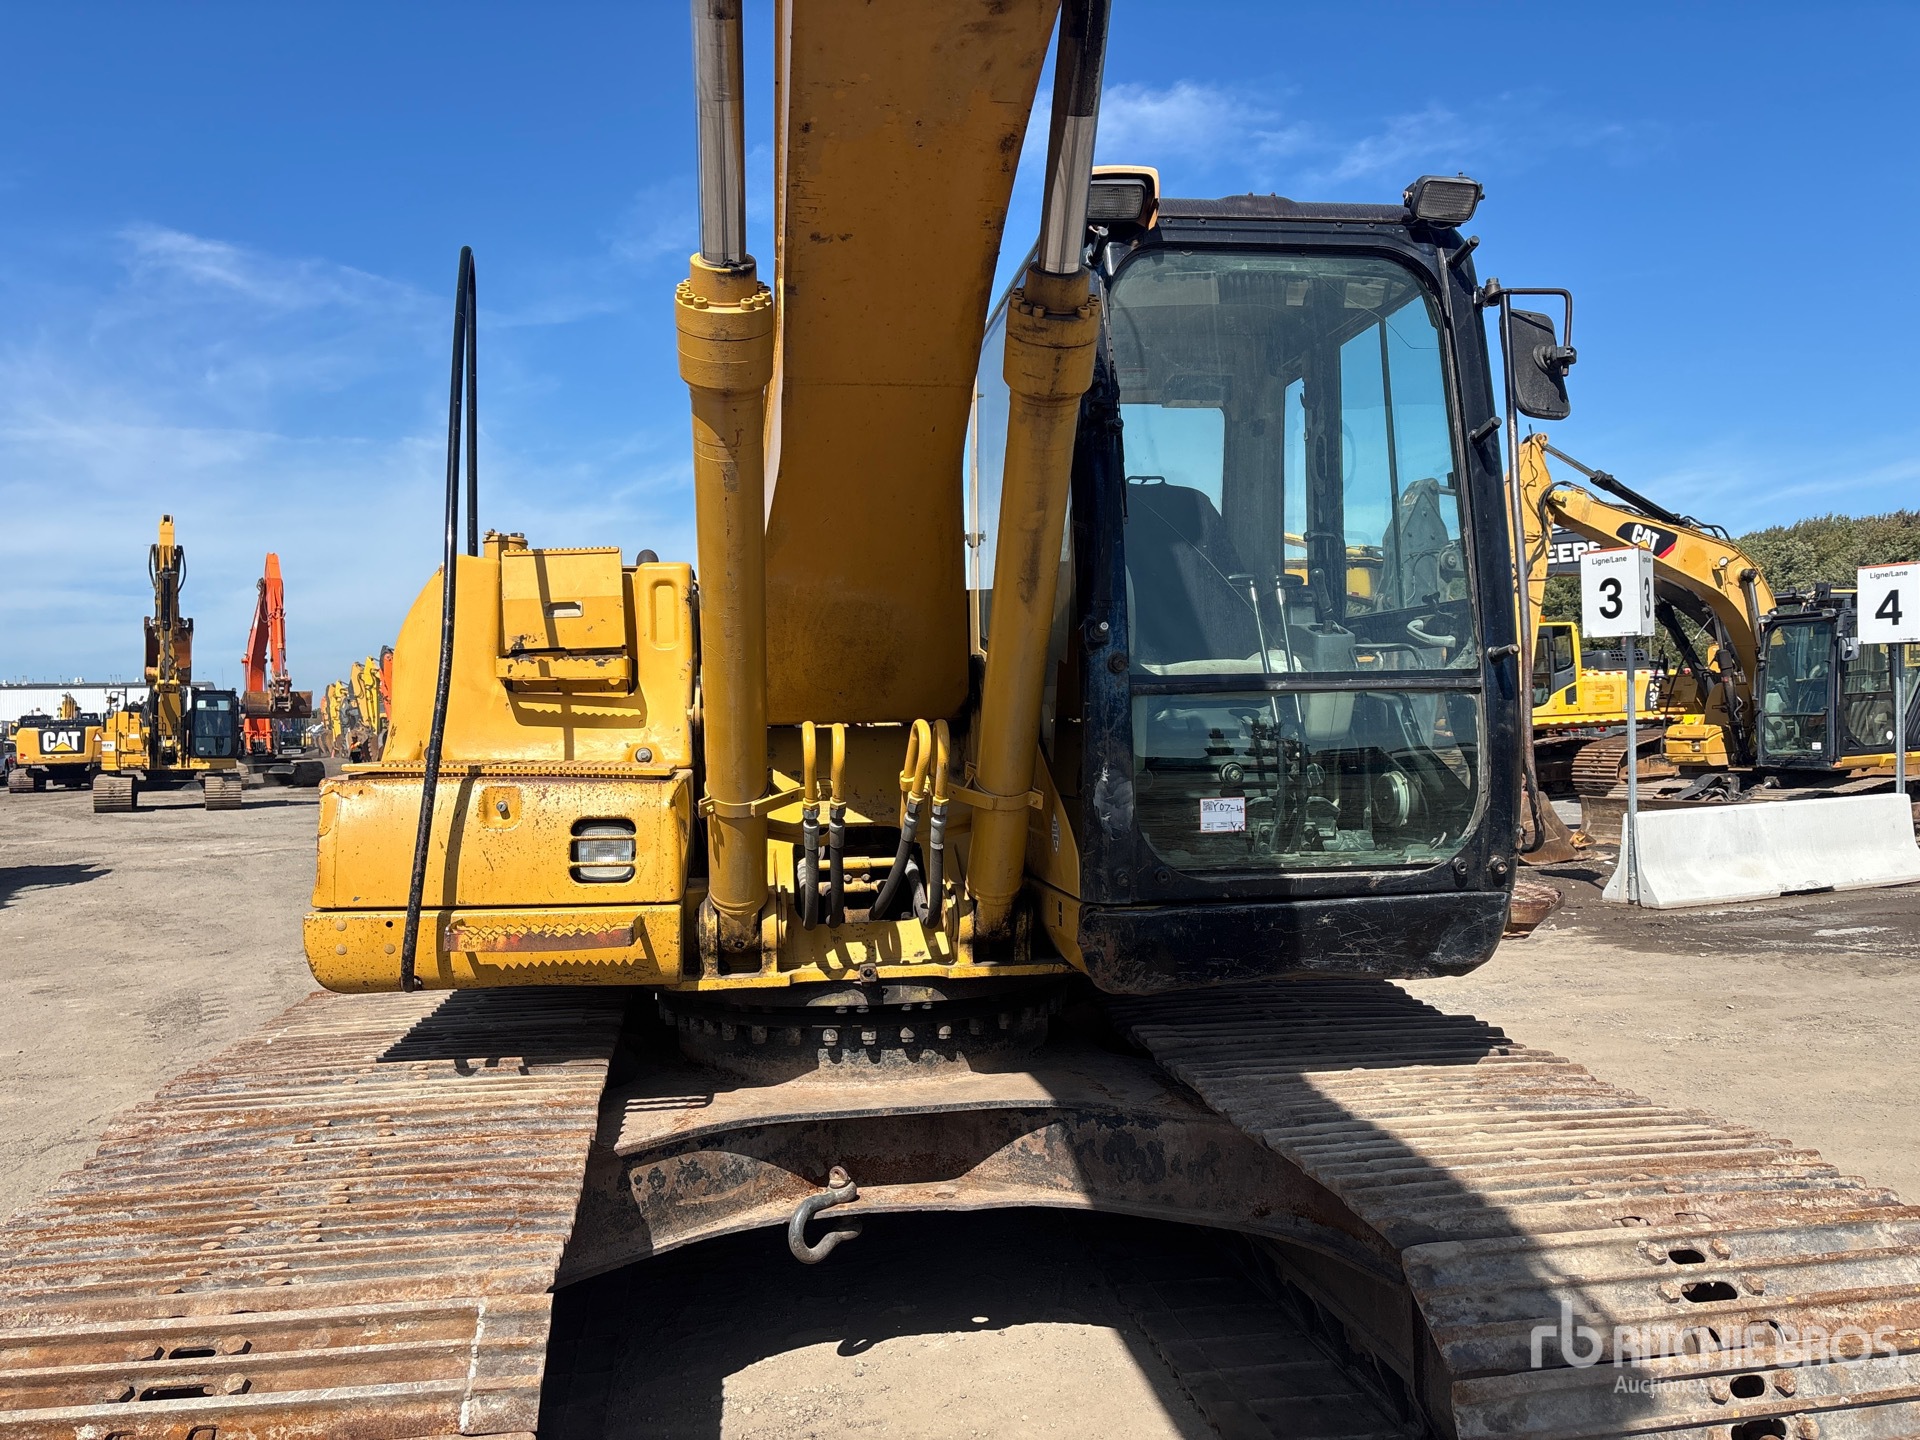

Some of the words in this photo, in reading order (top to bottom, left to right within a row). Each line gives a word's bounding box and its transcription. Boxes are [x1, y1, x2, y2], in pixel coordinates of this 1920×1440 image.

[1631, 524, 1660, 552] CAT
[1548, 541, 1602, 564] EER
[1592, 555, 1627, 566] Ligne/Lane
[1869, 570, 1908, 580] Ligne/Lane
[1599, 577, 1623, 619] 3
[1644, 577, 1651, 619] 3
[1875, 589, 1903, 626] 4
[42, 731, 81, 752] CAT
